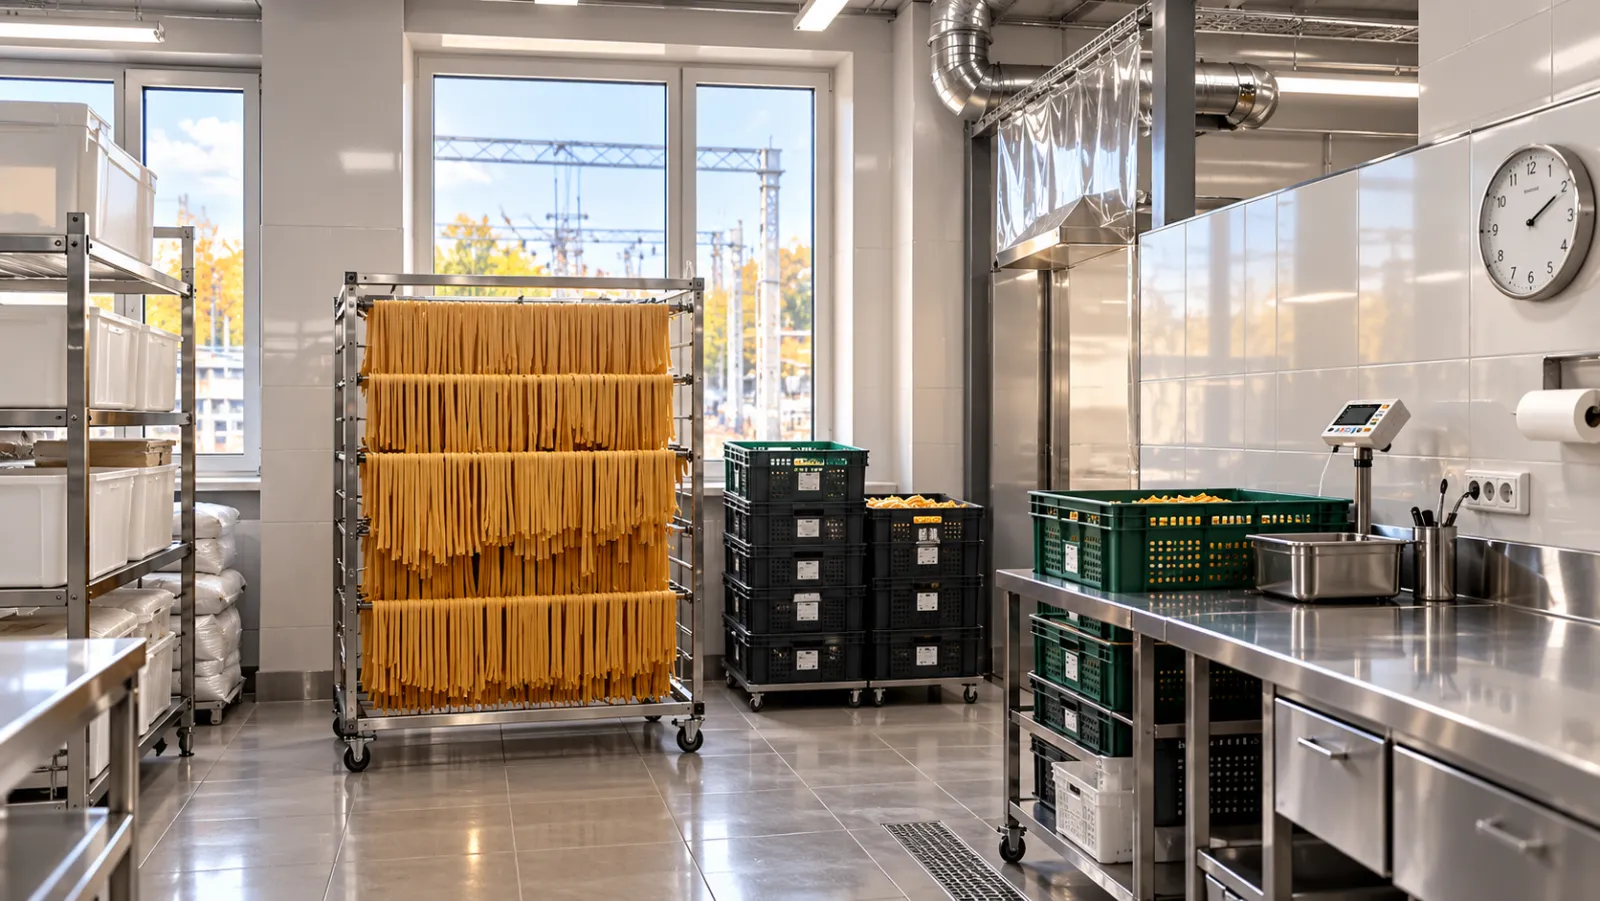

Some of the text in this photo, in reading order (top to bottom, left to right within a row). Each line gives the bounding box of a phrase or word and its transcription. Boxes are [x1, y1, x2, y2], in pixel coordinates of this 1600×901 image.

[1526, 161, 1536, 175] 12
[1548, 165, 1552, 177] 1
[1509, 173, 1517, 187] 11
[1561, 180, 1567, 193] 2
[1497, 196, 1506, 208] 10
[1567, 208, 1574, 222] 3
[1492, 224, 1498, 236] 9
[1560, 239, 1568, 252] 4
[1497, 250, 1504, 262] 8
[1510, 267, 1517, 280] 7
[1547, 261, 1553, 274] 5
[1528, 271, 1534, 283] 6
